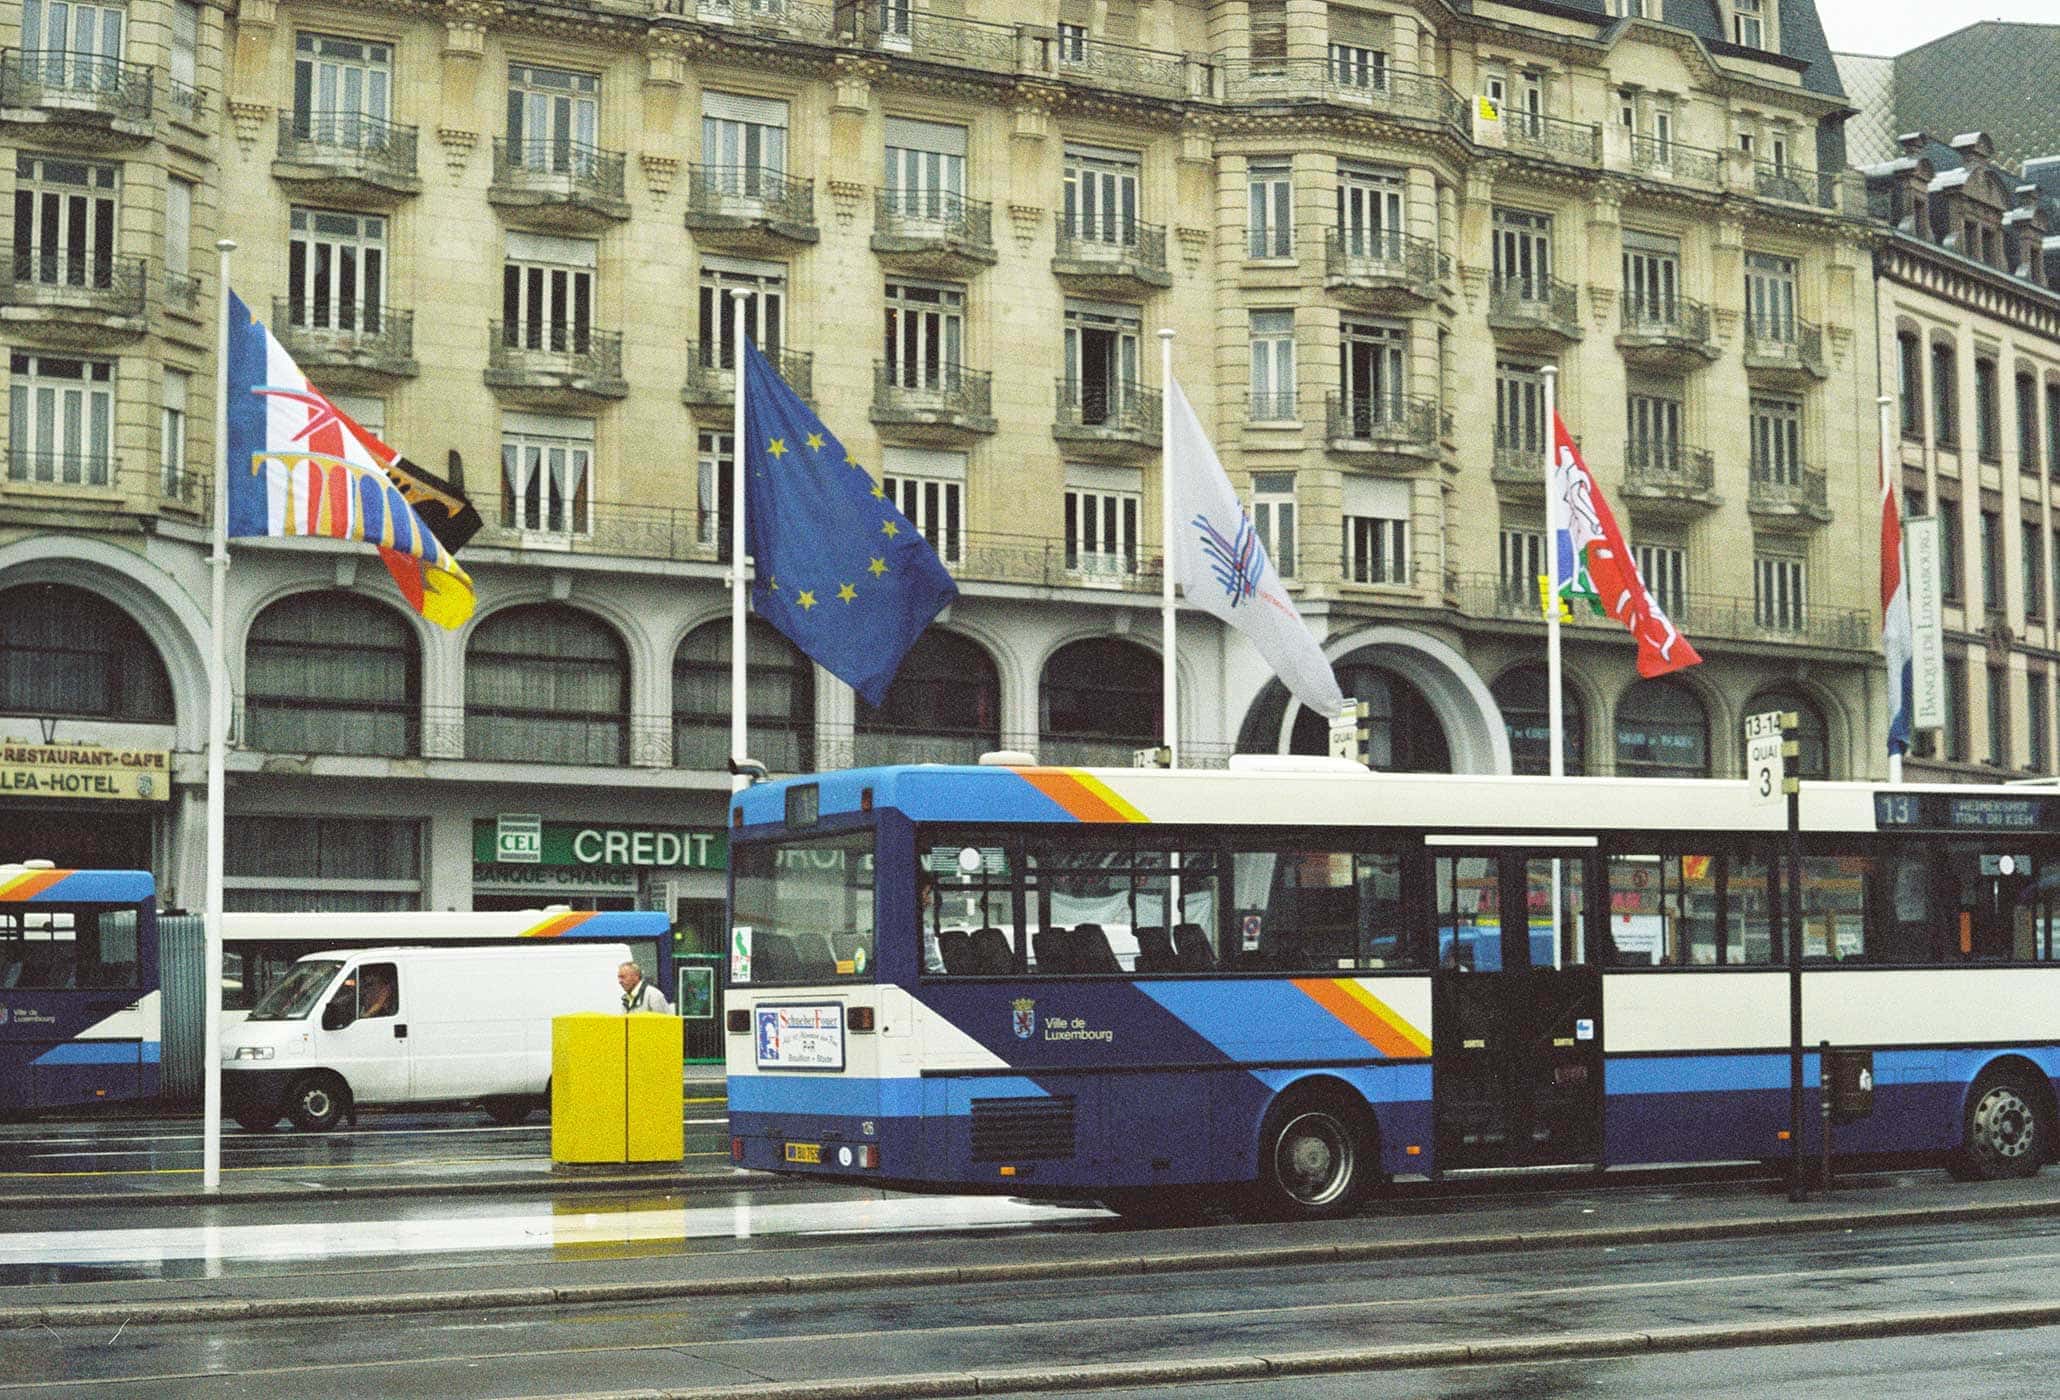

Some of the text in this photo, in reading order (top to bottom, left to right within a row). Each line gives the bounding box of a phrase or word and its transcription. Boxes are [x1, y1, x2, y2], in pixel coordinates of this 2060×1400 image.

[1753, 744, 1778, 761] QUAI
[1760, 767, 1772, 797] 3
[1880, 796, 1909, 824] 13
[500, 834, 539, 852] CEL
[574, 829, 714, 866] CREDIT
[1044, 1017, 1086, 1029] Ville de
[1044, 1029, 1114, 1042] Luxembourg
